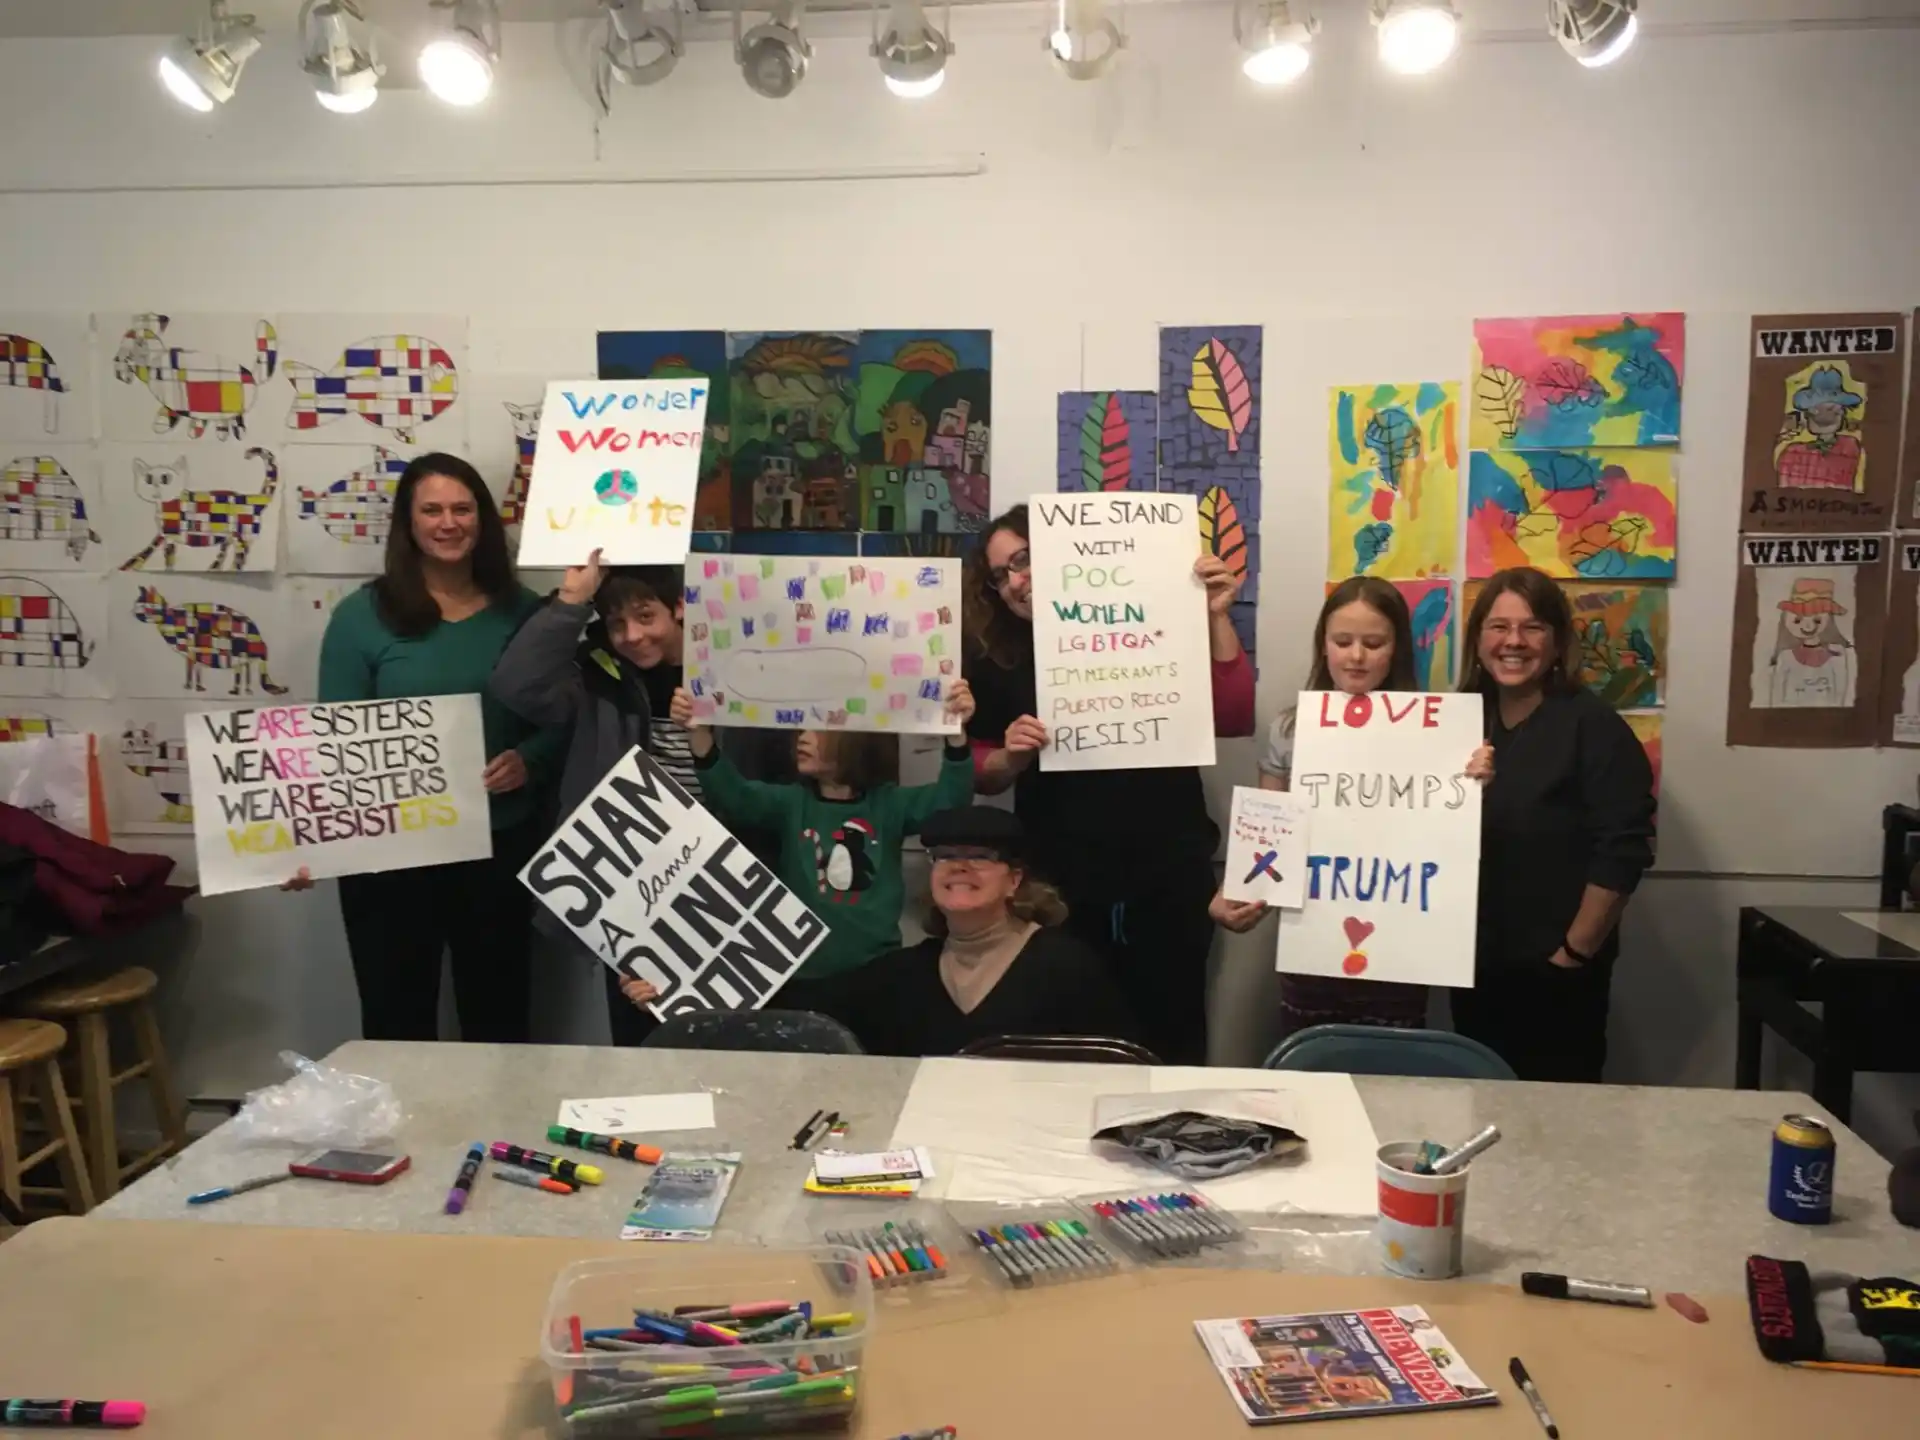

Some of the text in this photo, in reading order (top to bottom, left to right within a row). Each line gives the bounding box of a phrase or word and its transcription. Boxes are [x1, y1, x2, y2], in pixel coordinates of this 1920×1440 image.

[1760, 327, 1895, 354] WANTED
[561, 387, 706, 419] Wonder
[557, 426, 701, 454] Women
[1039, 500, 1183, 526] WE STAND
[1073, 537, 1136, 556] WITH
[1747, 538, 1880, 564] WANTED
[1061, 563, 1135, 592] POC
[1052, 600, 1145, 626] WOMEN
[1046, 662, 1178, 688] IMMIGRANTS
[1052, 691, 1181, 720] PUERTO RICO
[1320, 692, 1443, 728] LOVE
[1054, 717, 1169, 754] RESIST
[1299, 772, 1466, 809] TRUMPS
[527, 751, 696, 928] SHAM
[637, 836, 702, 917] lama
[1306, 855, 1439, 912] TRUMP
[616, 836, 776, 1009] DING
[1368, 1309, 1461, 1402] THE WEEK
